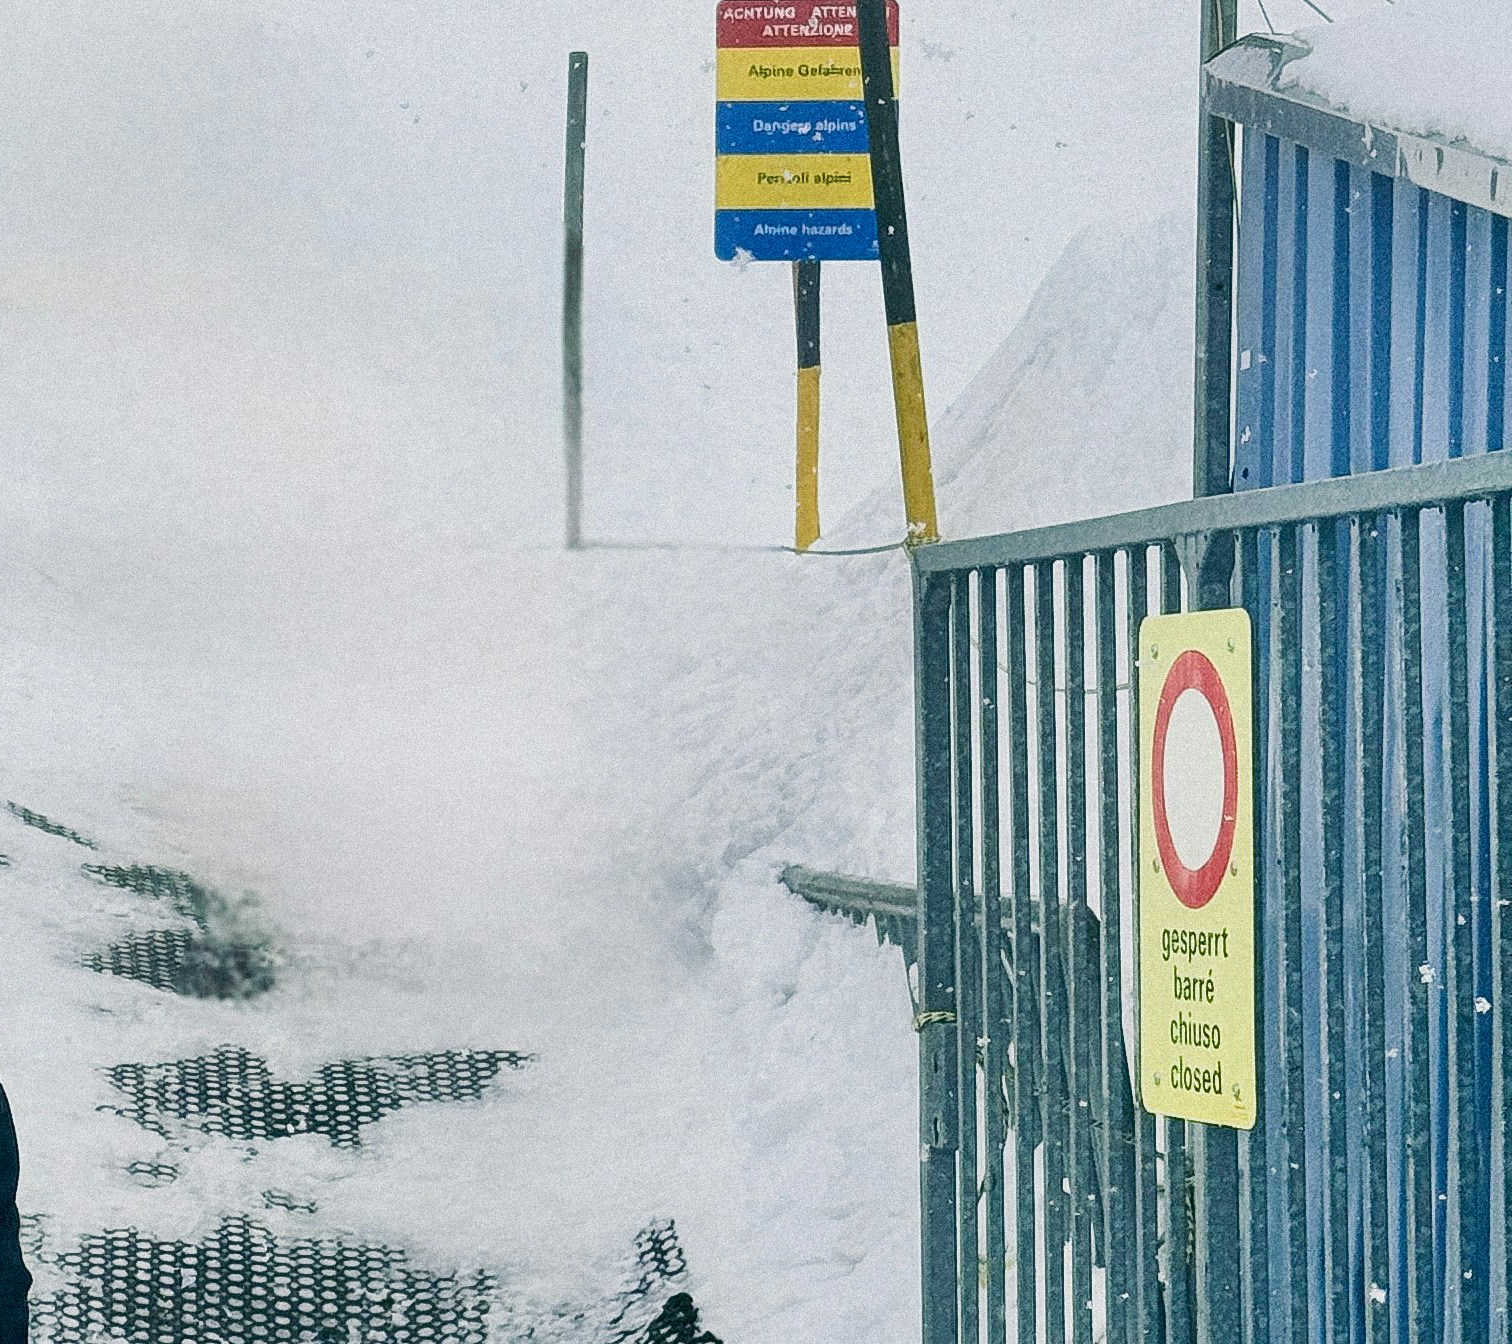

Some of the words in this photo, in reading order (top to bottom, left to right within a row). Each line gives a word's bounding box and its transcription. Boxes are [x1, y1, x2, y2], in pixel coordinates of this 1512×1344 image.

[723, 6, 796, 20] ACHTUNG
[762, 24, 854, 38] ATTENZIONE
[748, 63, 794, 79] Alpine
[798, 63, 861, 78] Gefahren
[815, 119, 857, 134] alpins
[753, 223, 798, 237] Alpine
[801, 222, 853, 236] hazards
[1162, 927, 1228, 963] gesperrt
[1174, 965, 1215, 1003] barré
[1170, 1011, 1221, 1049] chiuso
[1171, 1056, 1222, 1095] closed
